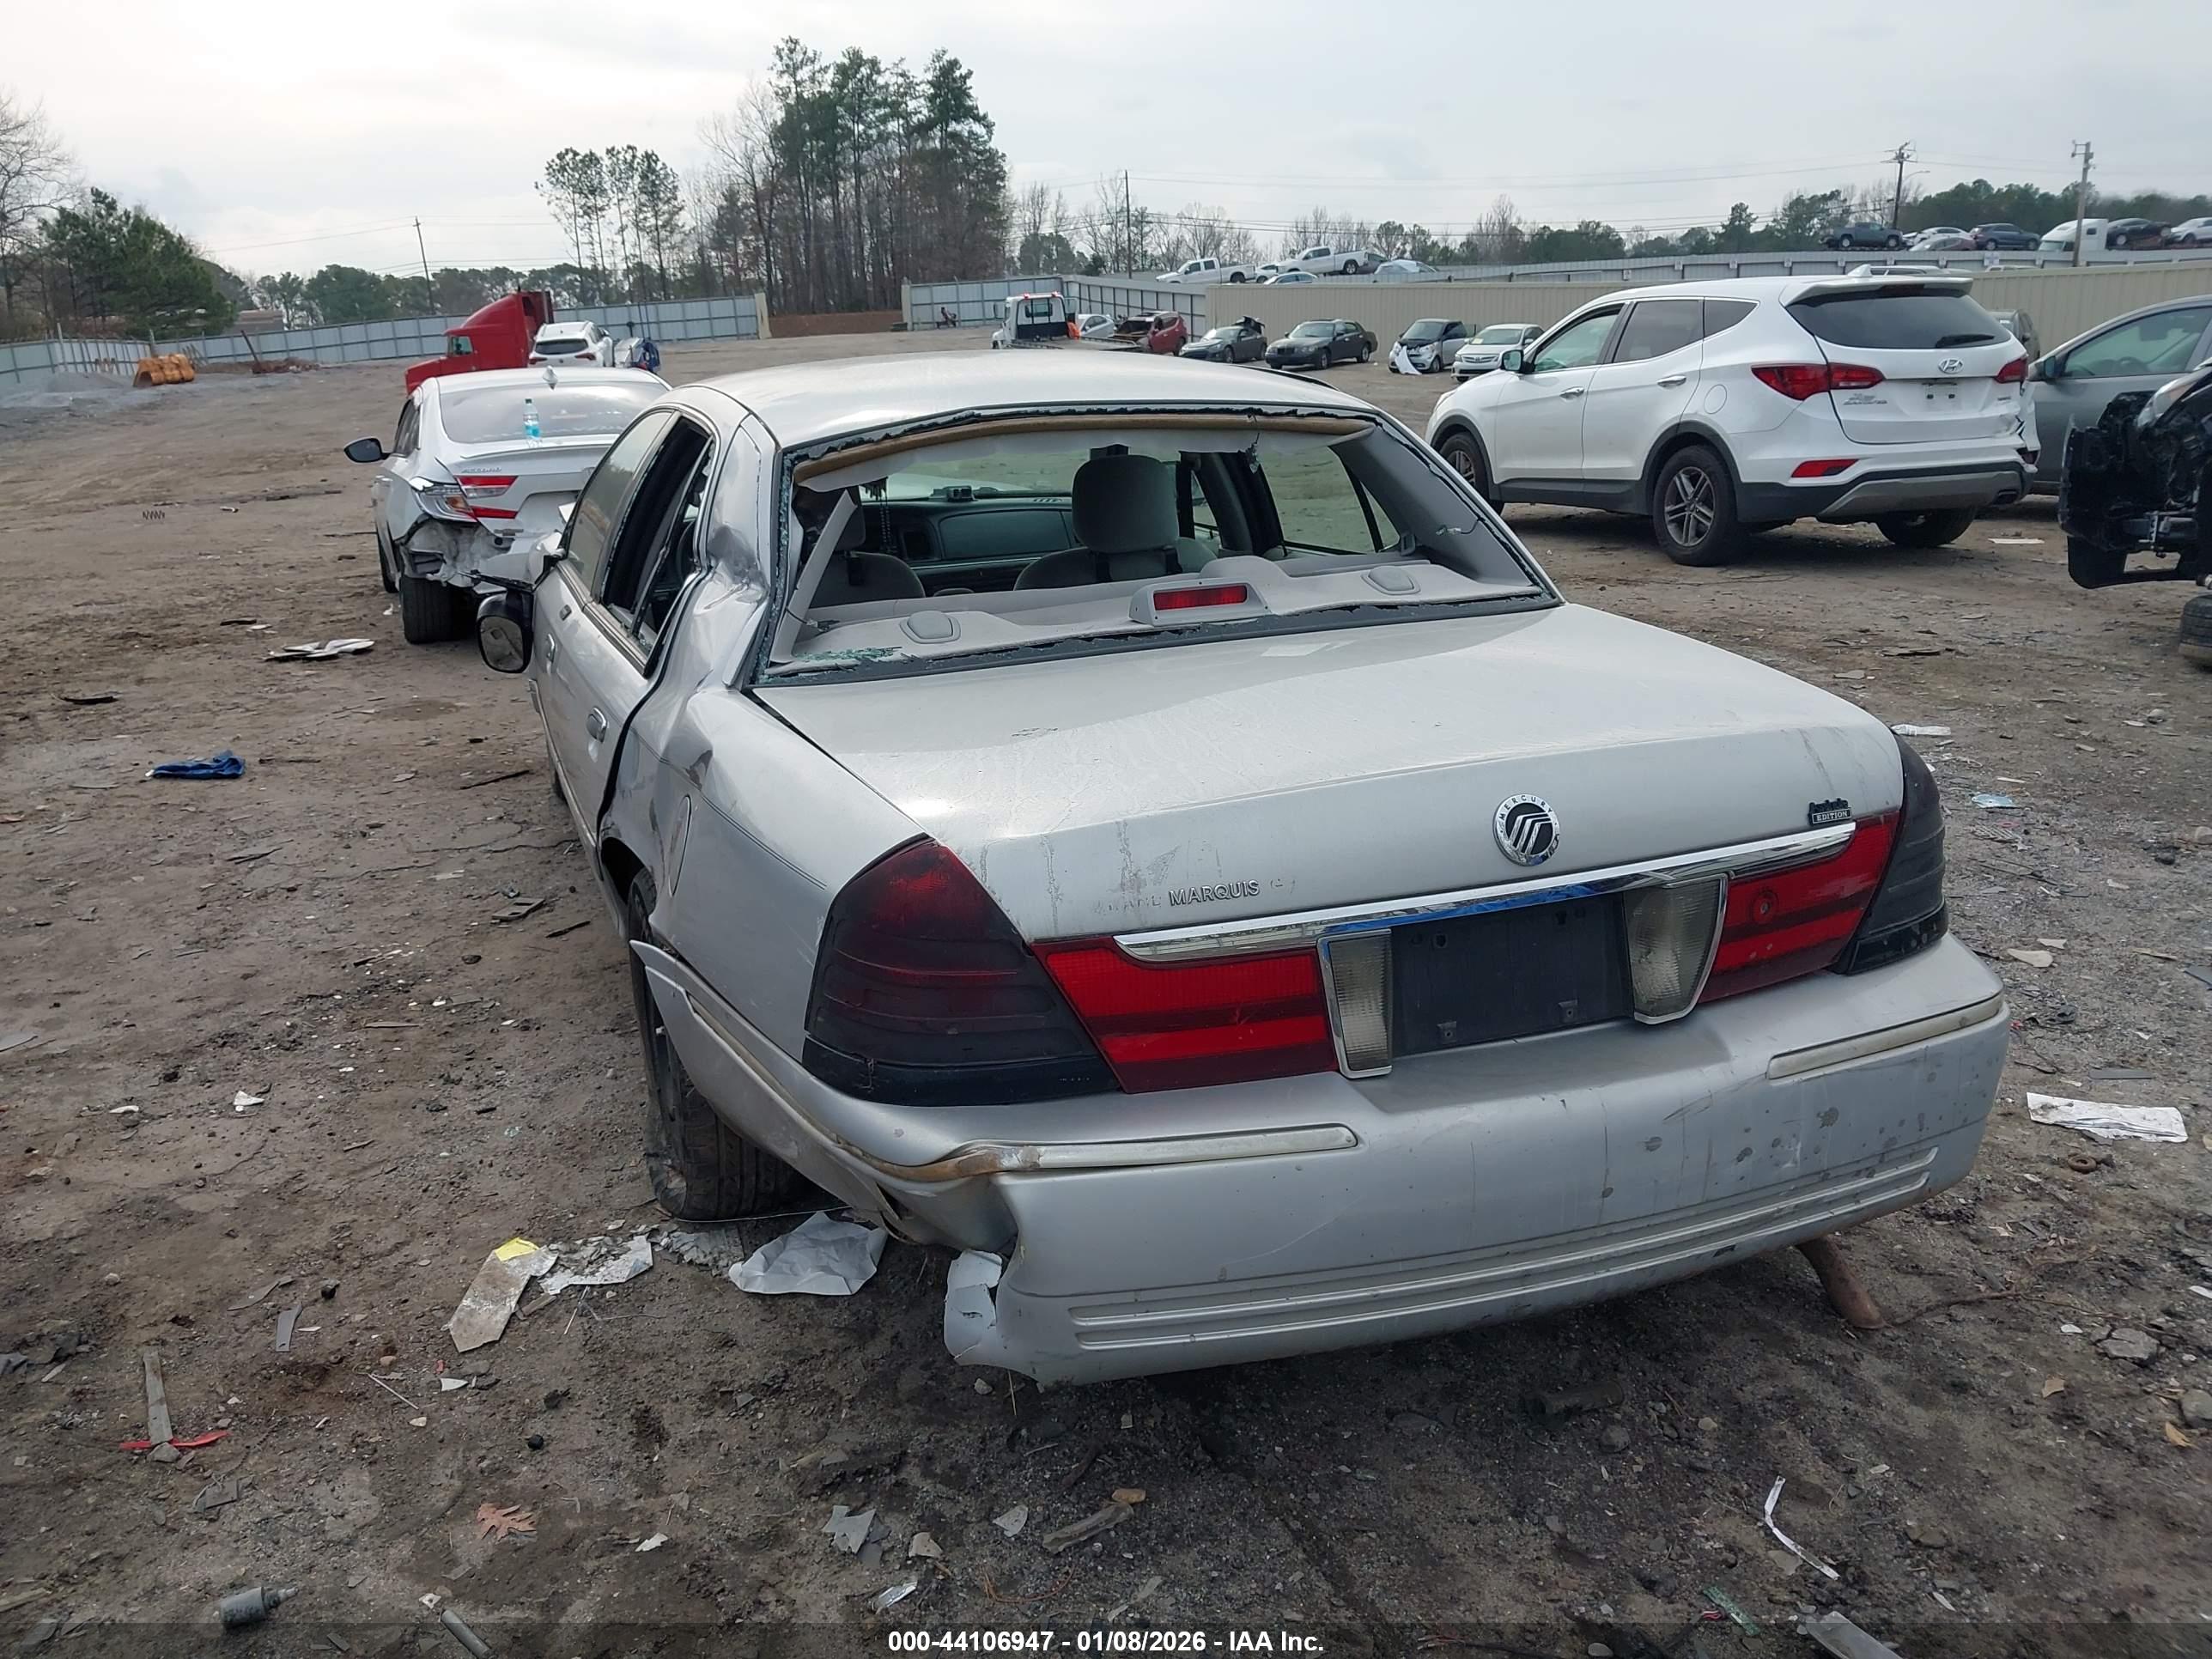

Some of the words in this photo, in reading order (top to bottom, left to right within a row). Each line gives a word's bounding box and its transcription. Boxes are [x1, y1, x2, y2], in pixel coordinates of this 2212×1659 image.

[1498, 794, 1553, 821] MERCURY
[1815, 810, 1849, 822] EDITION
[1168, 878, 1260, 907] MARQUIS
